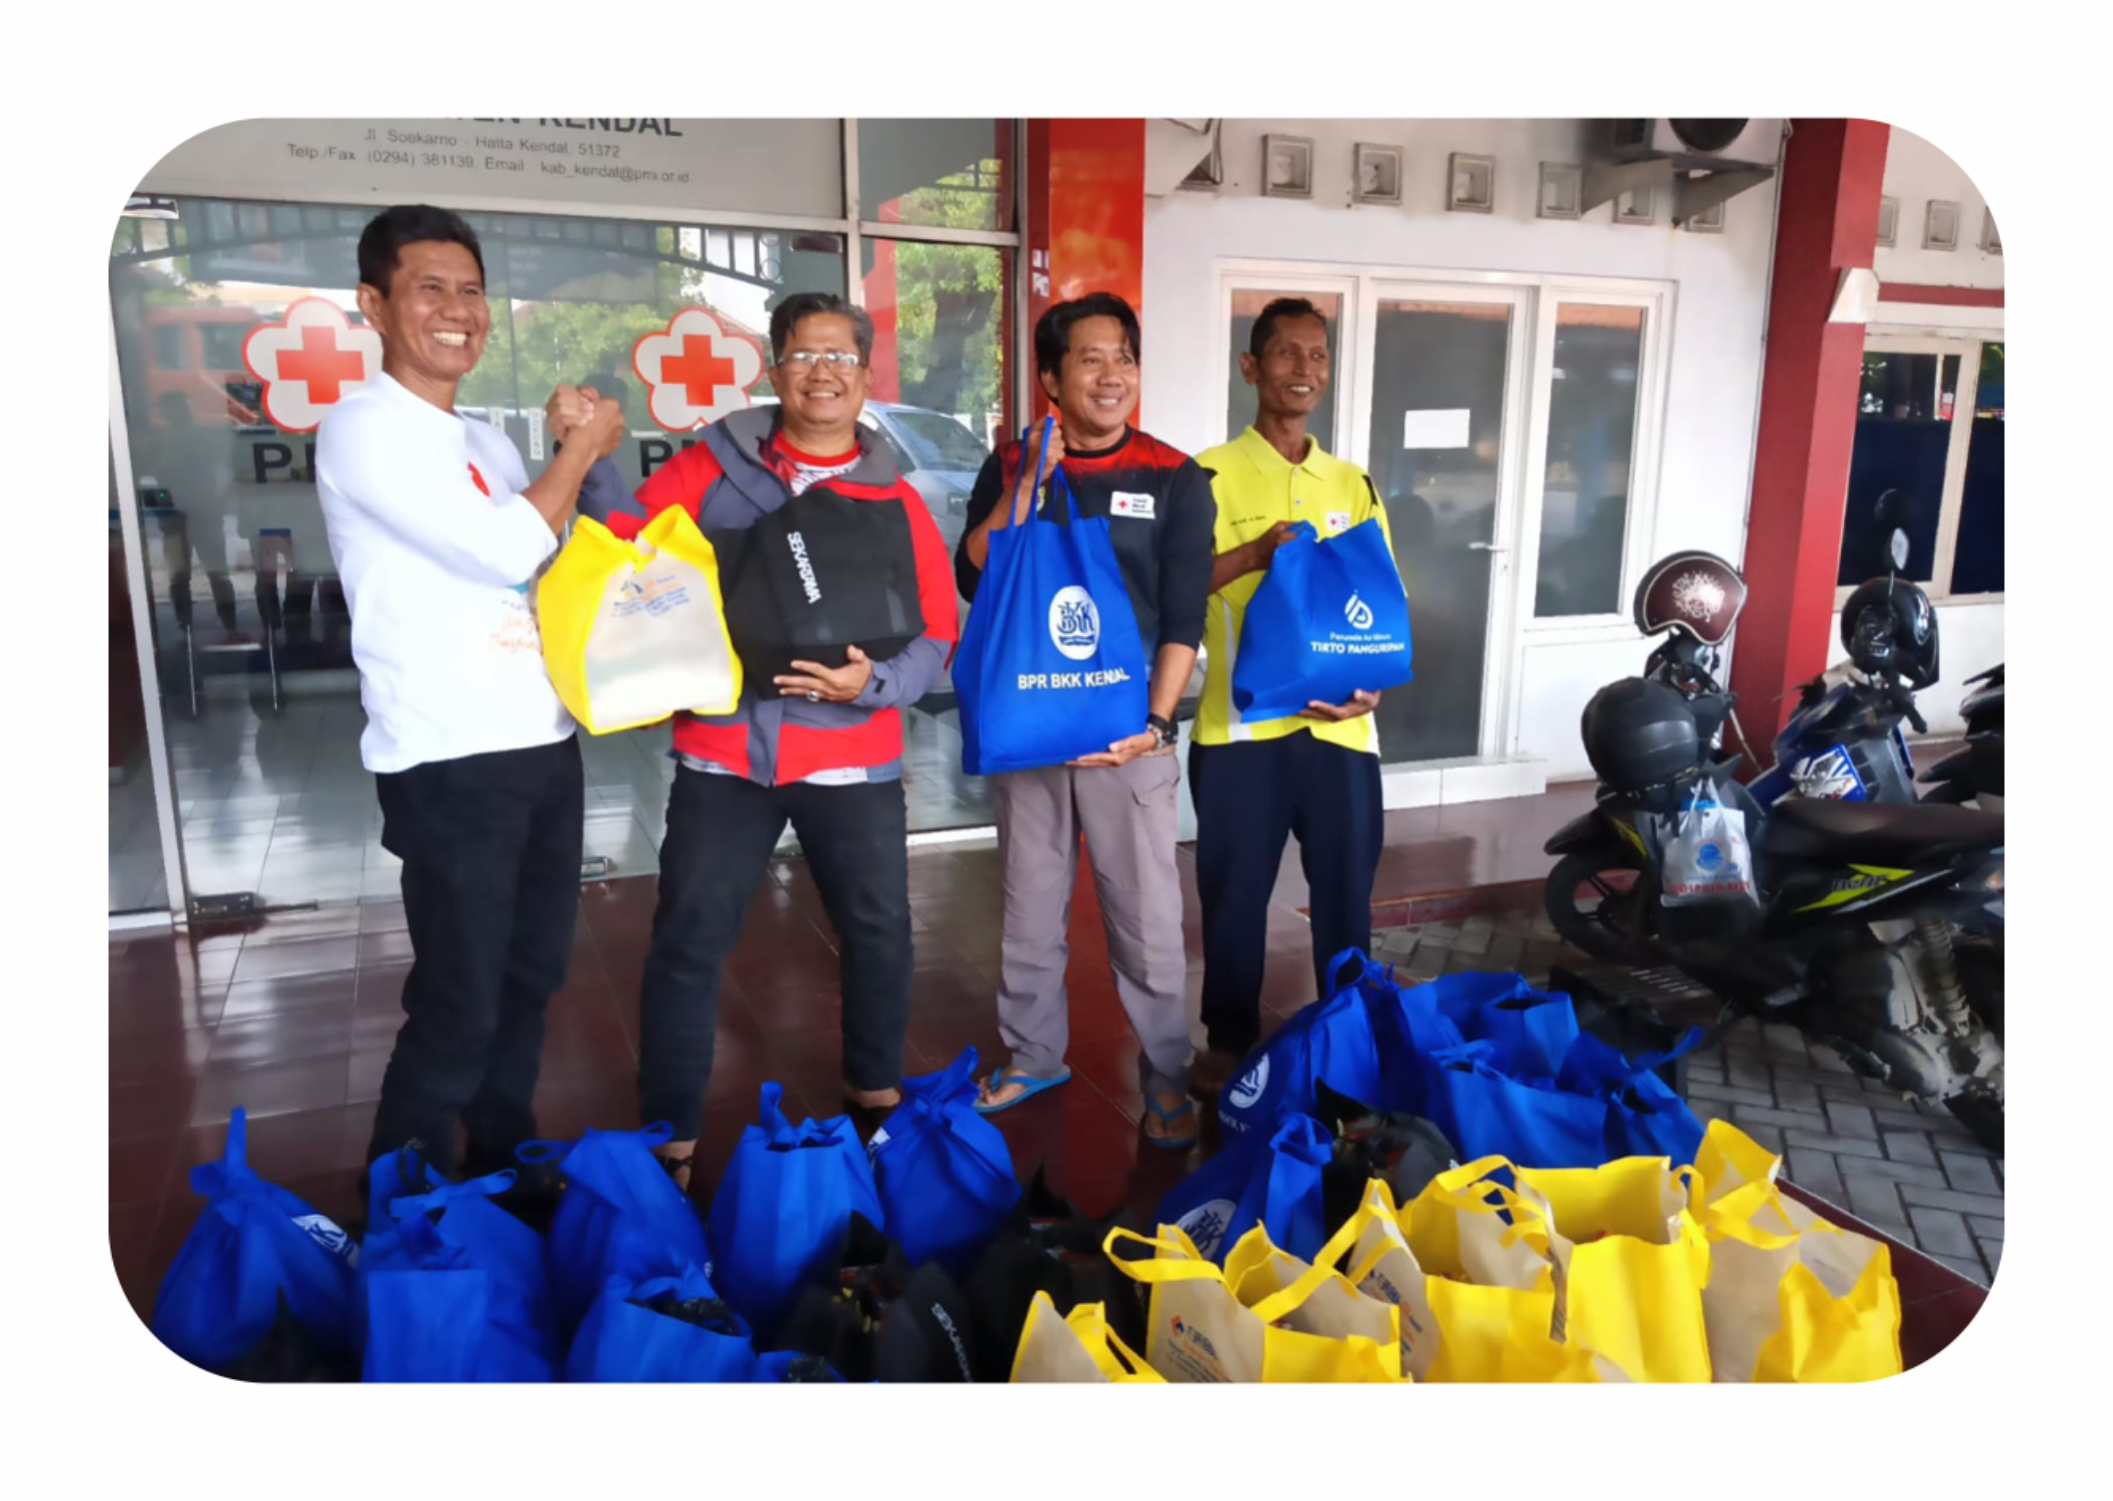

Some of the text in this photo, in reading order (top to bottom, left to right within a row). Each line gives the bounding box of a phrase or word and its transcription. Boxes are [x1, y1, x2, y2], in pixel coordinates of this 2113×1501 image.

[387, 128, 458, 147] Soekarno
[475, 135, 513, 150] Hatta
[578, 142, 621, 158] 51372
[367, 149, 416, 167] (0294)
[1310, 641, 1346, 654] TIRTO
[1018, 673, 1048, 689] BPR
[1050, 672, 1082, 688] BKK
